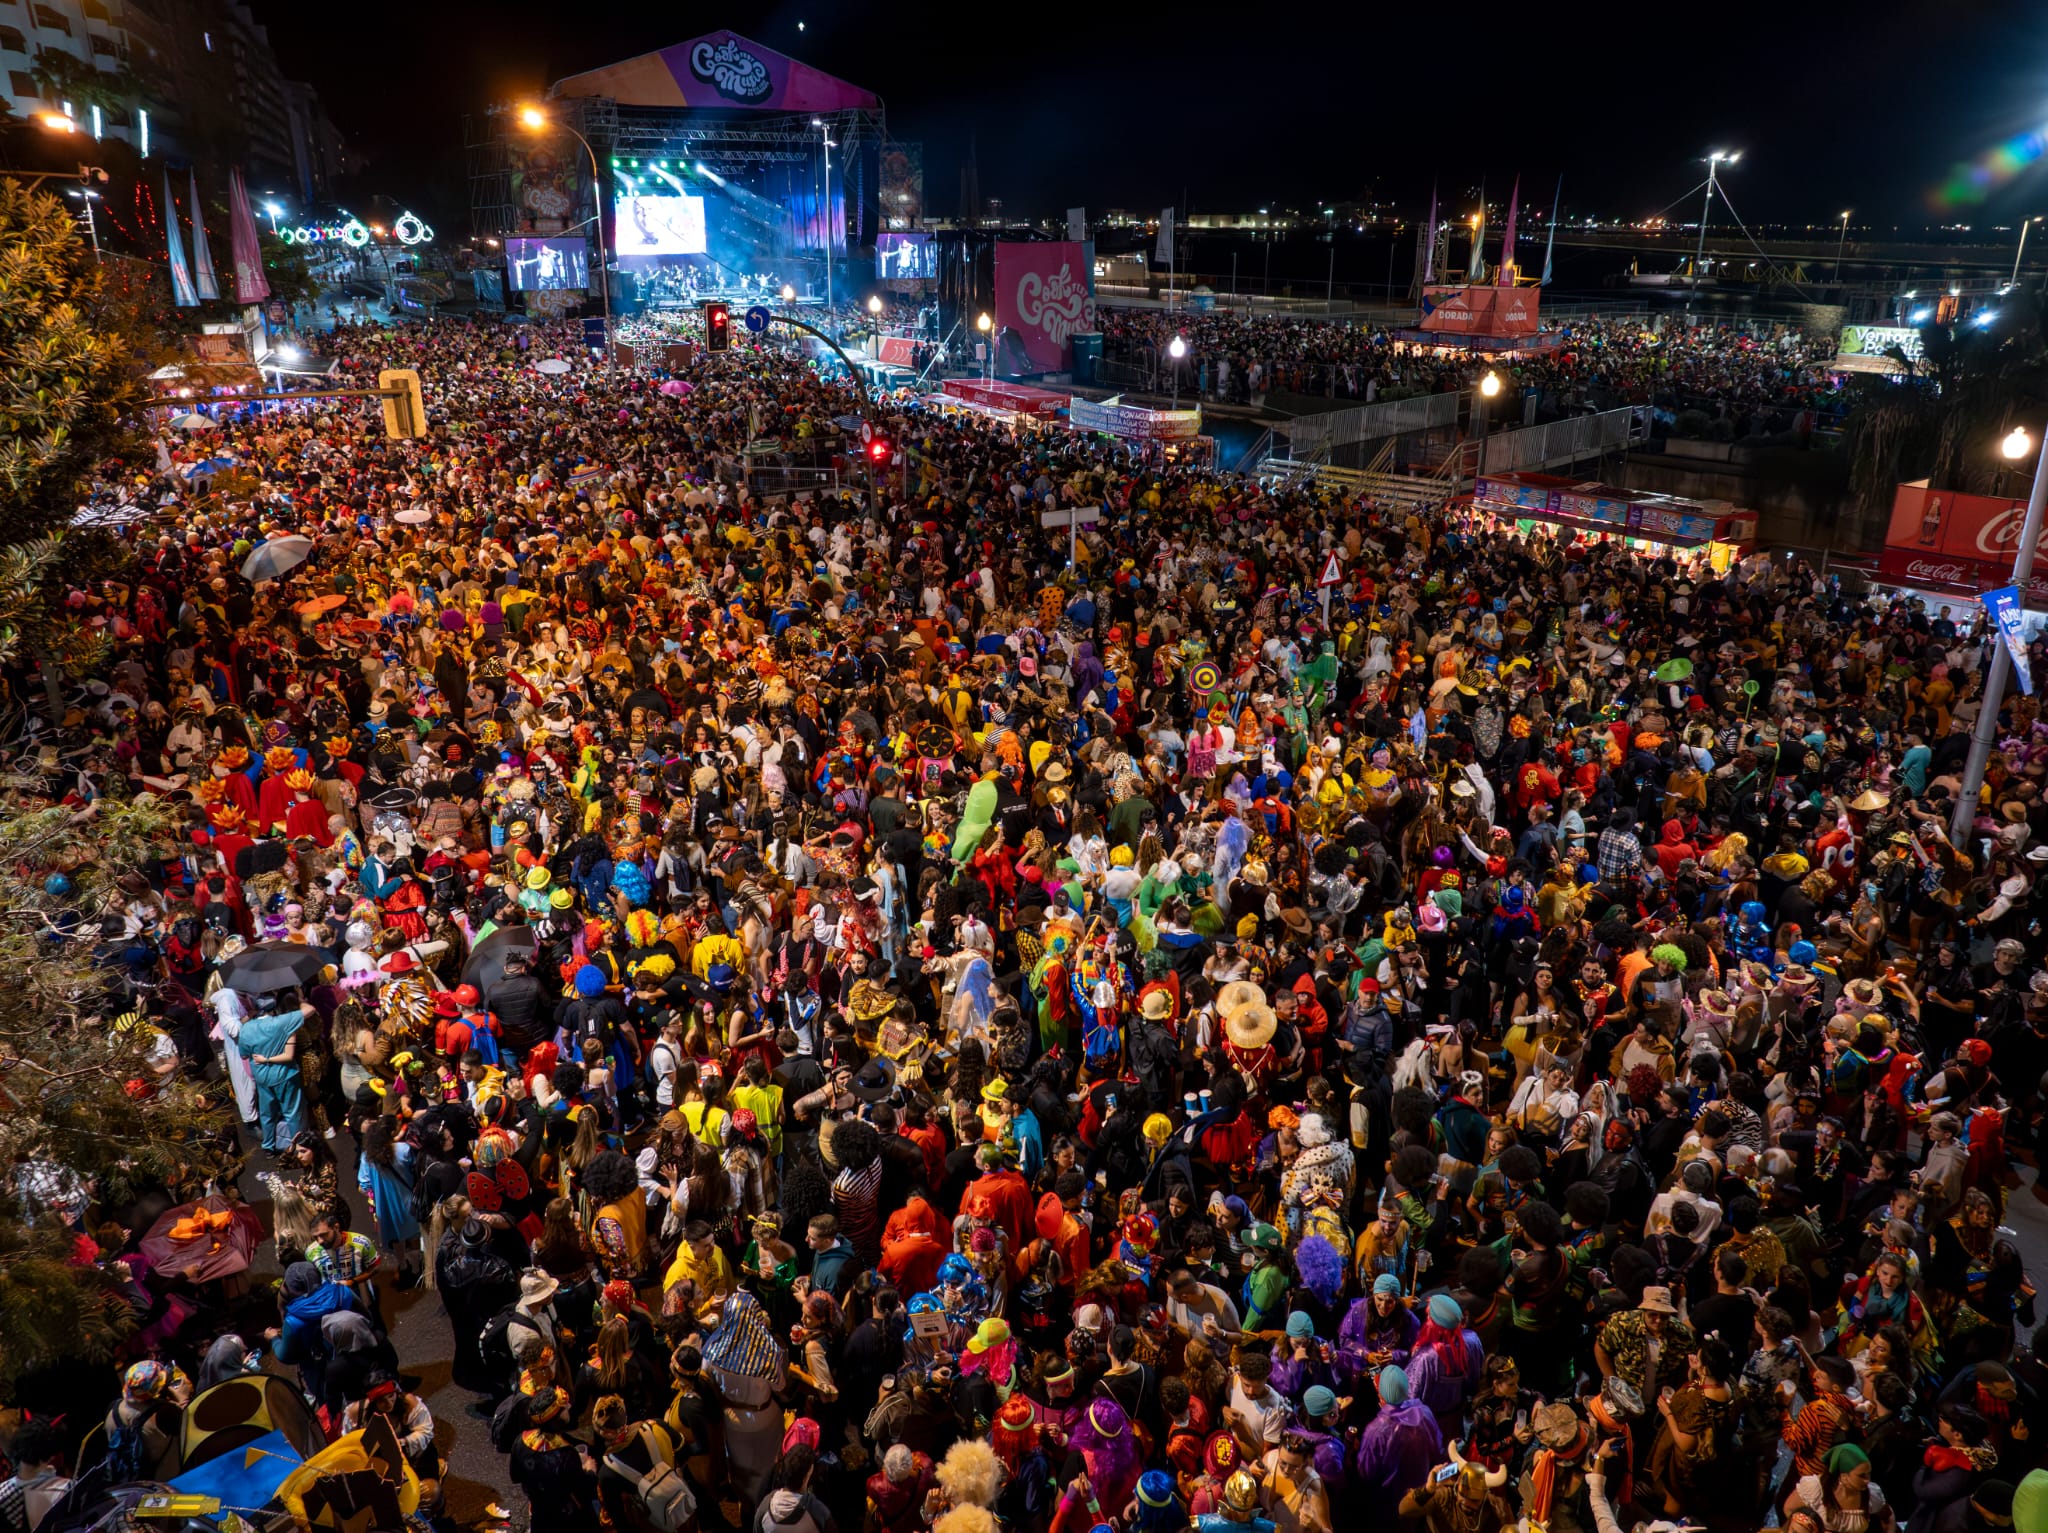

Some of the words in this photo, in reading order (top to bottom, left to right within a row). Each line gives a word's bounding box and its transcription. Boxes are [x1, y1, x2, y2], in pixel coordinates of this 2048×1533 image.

[692, 39, 752, 76] Cook
[1017, 263, 1082, 326] Cook
[1439, 311, 1473, 321] DORADA
[1505, 311, 1527, 321] DORADA
[1907, 560, 1967, 582] Coca-Cola
